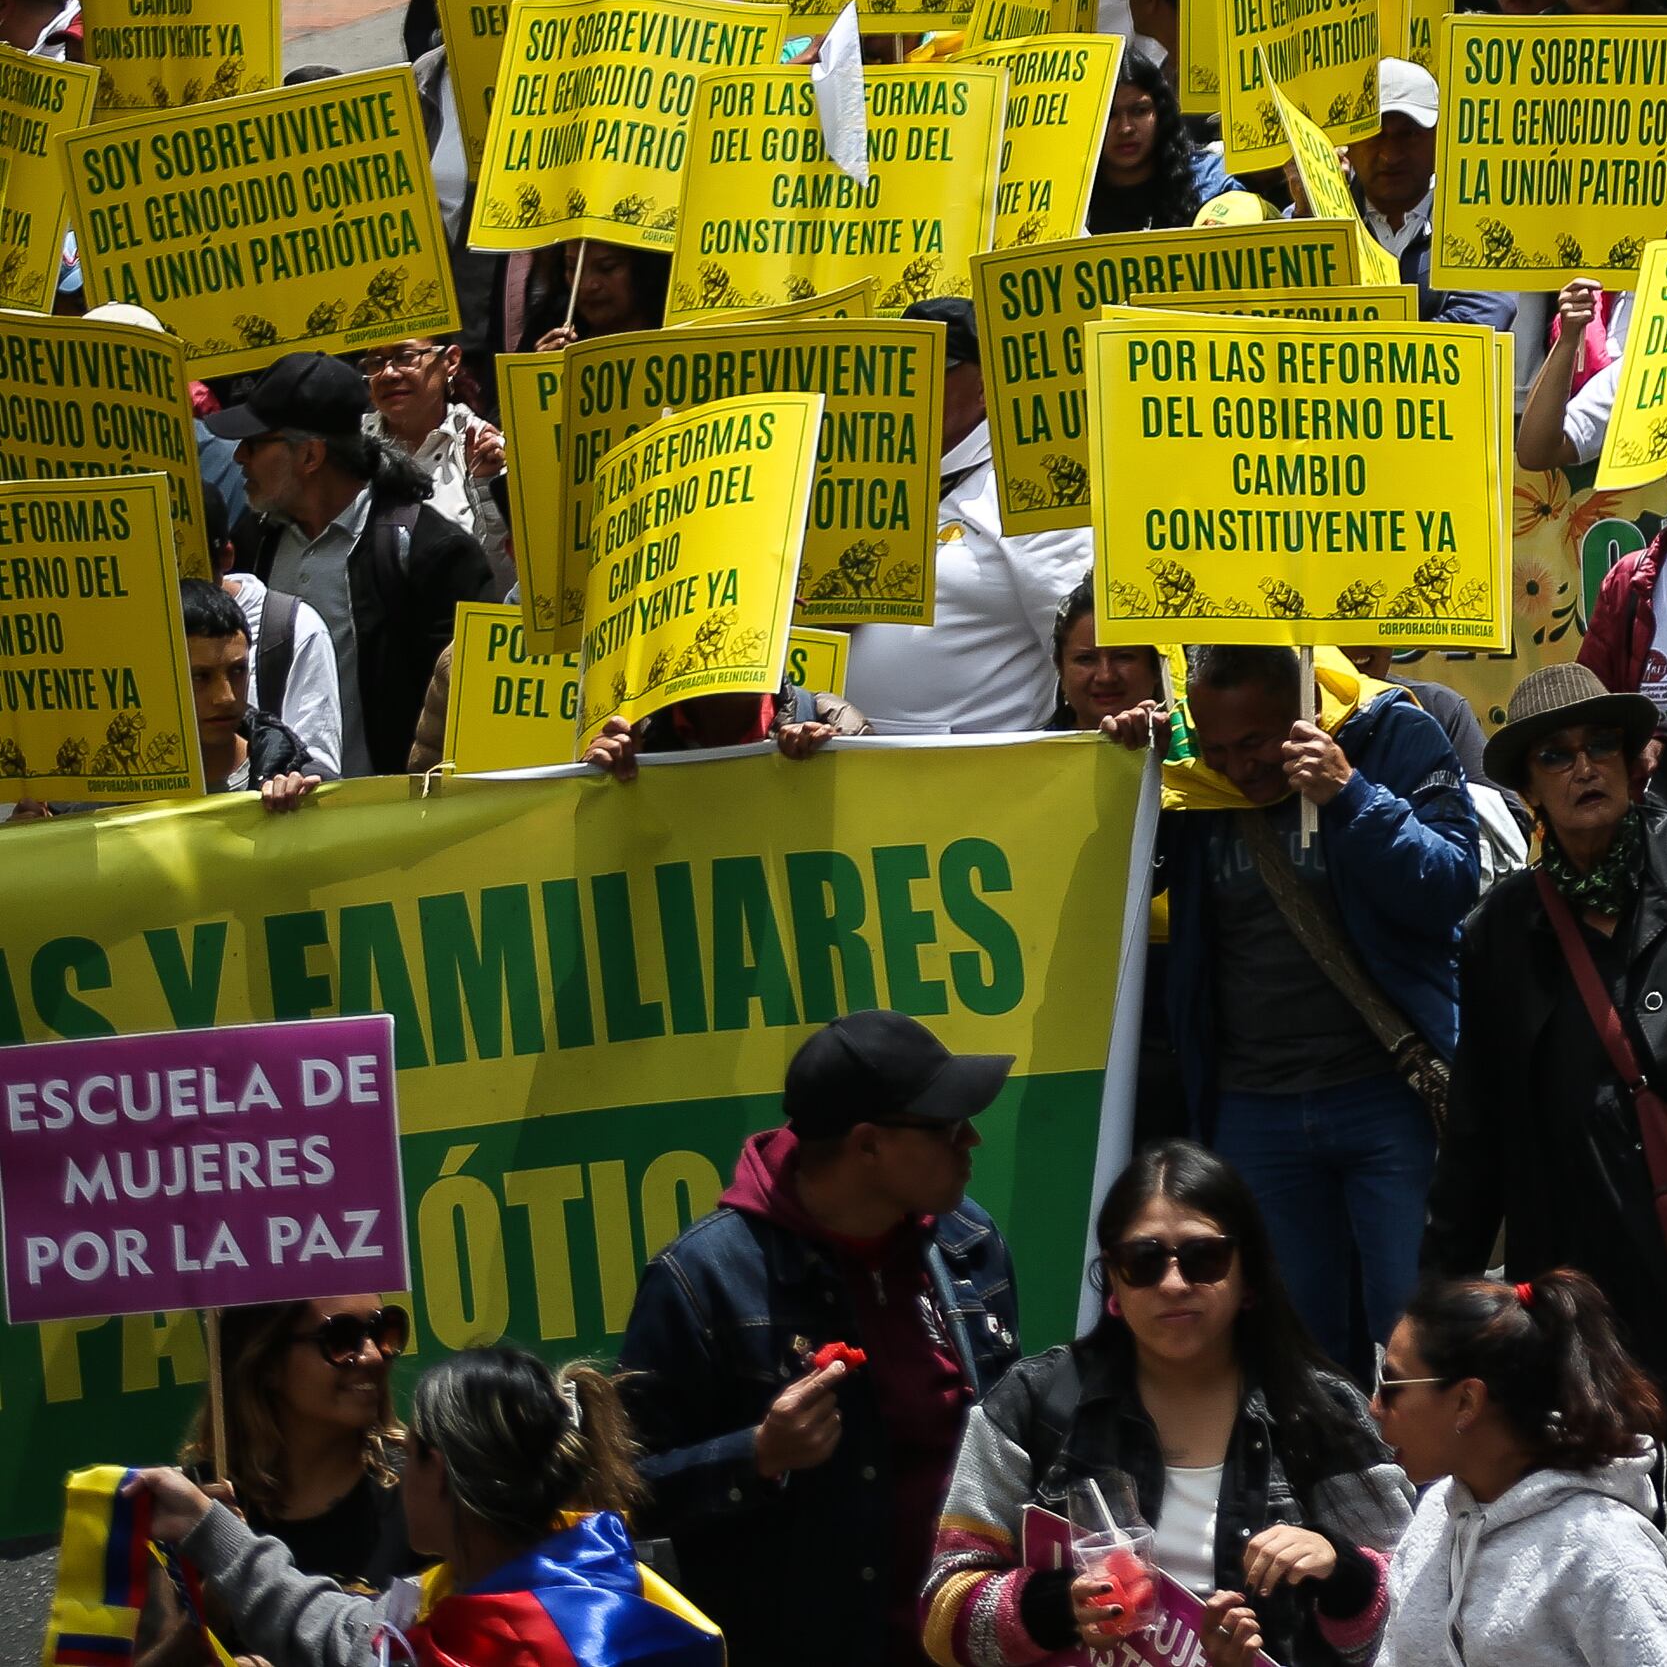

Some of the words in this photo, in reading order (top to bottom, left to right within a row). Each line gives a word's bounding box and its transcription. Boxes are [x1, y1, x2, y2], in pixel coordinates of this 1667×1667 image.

[82, 139, 143, 195] SOY
[151, 91, 399, 180] SOBREVIVIENTE
[89, 202, 143, 255] DEL
[144, 170, 298, 244] GENOCIDIO
[303, 149, 415, 213] CONTRA
[102, 261, 141, 304] LA
[146, 234, 245, 302] UNIÓN
[249, 209, 422, 285] PATRIÓTICA
[1128, 340, 1196, 382] POR
[1209, 341, 1266, 383] LAS
[1277, 342, 1461, 385] REFORMAS
[1142, 396, 1203, 438] DEL
[1213, 396, 1383, 440] GOBIERNO
[1396, 398, 1454, 440] DEL
[1233, 454, 1366, 496] CAMBIO
[1145, 509, 1405, 553] CONSTITUYENTE
[1416, 511, 1457, 552] YA
[1378, 621, 1448, 635] CORPORACIÓN
[1450, 623, 1493, 637] REINICIAR
[270, 837, 1025, 1072] FAMILIARES
[7, 1063, 283, 1132] ESCUELA
[300, 1054, 381, 1108] DE
[62, 1137, 336, 1206] MUJERES
[25, 1229, 153, 1287] POR
[172, 1220, 251, 1273] LA
[268, 1210, 385, 1266] PAZ
